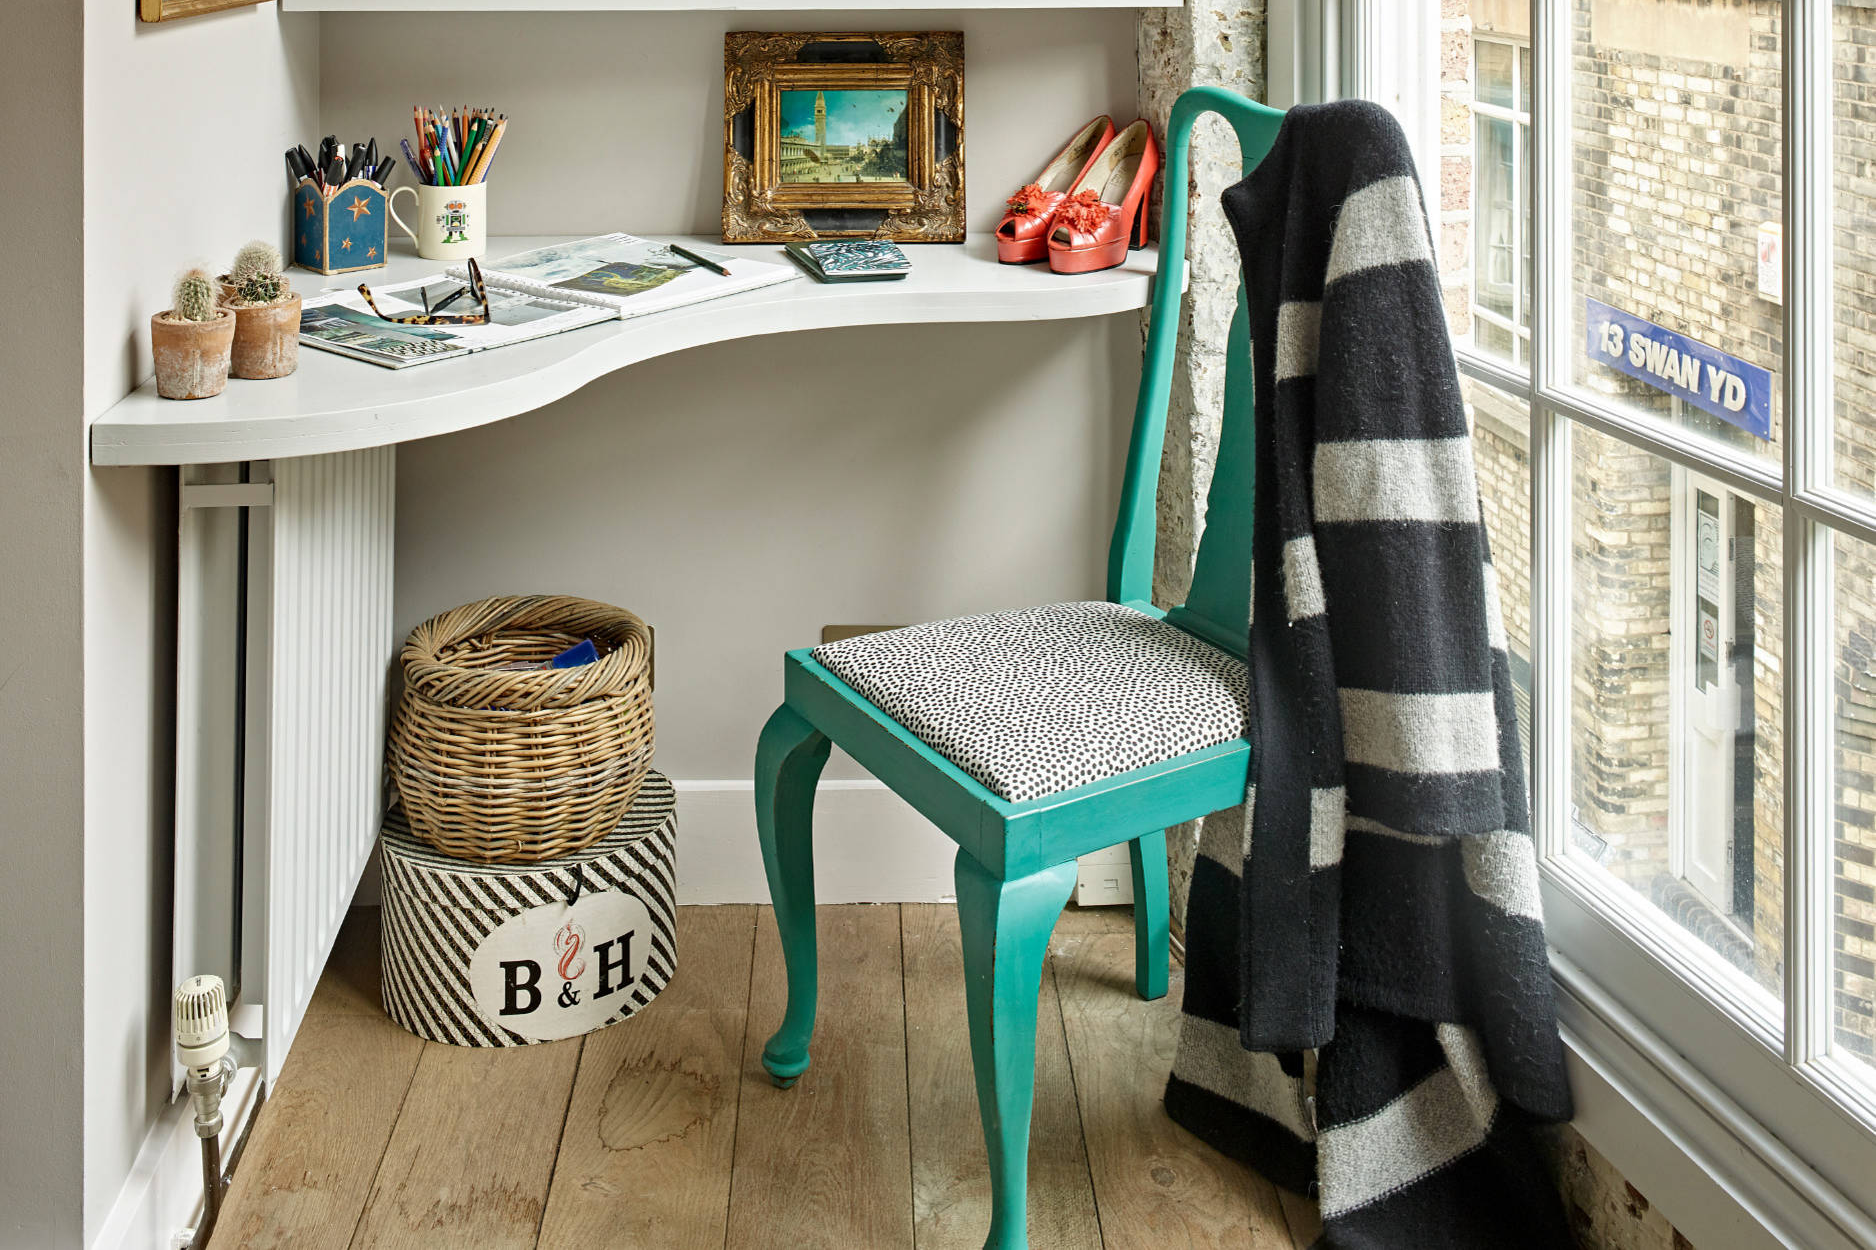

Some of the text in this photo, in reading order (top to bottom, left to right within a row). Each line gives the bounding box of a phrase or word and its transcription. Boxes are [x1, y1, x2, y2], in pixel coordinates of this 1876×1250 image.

[1599, 321, 1746, 412] 13 SWAN YD
